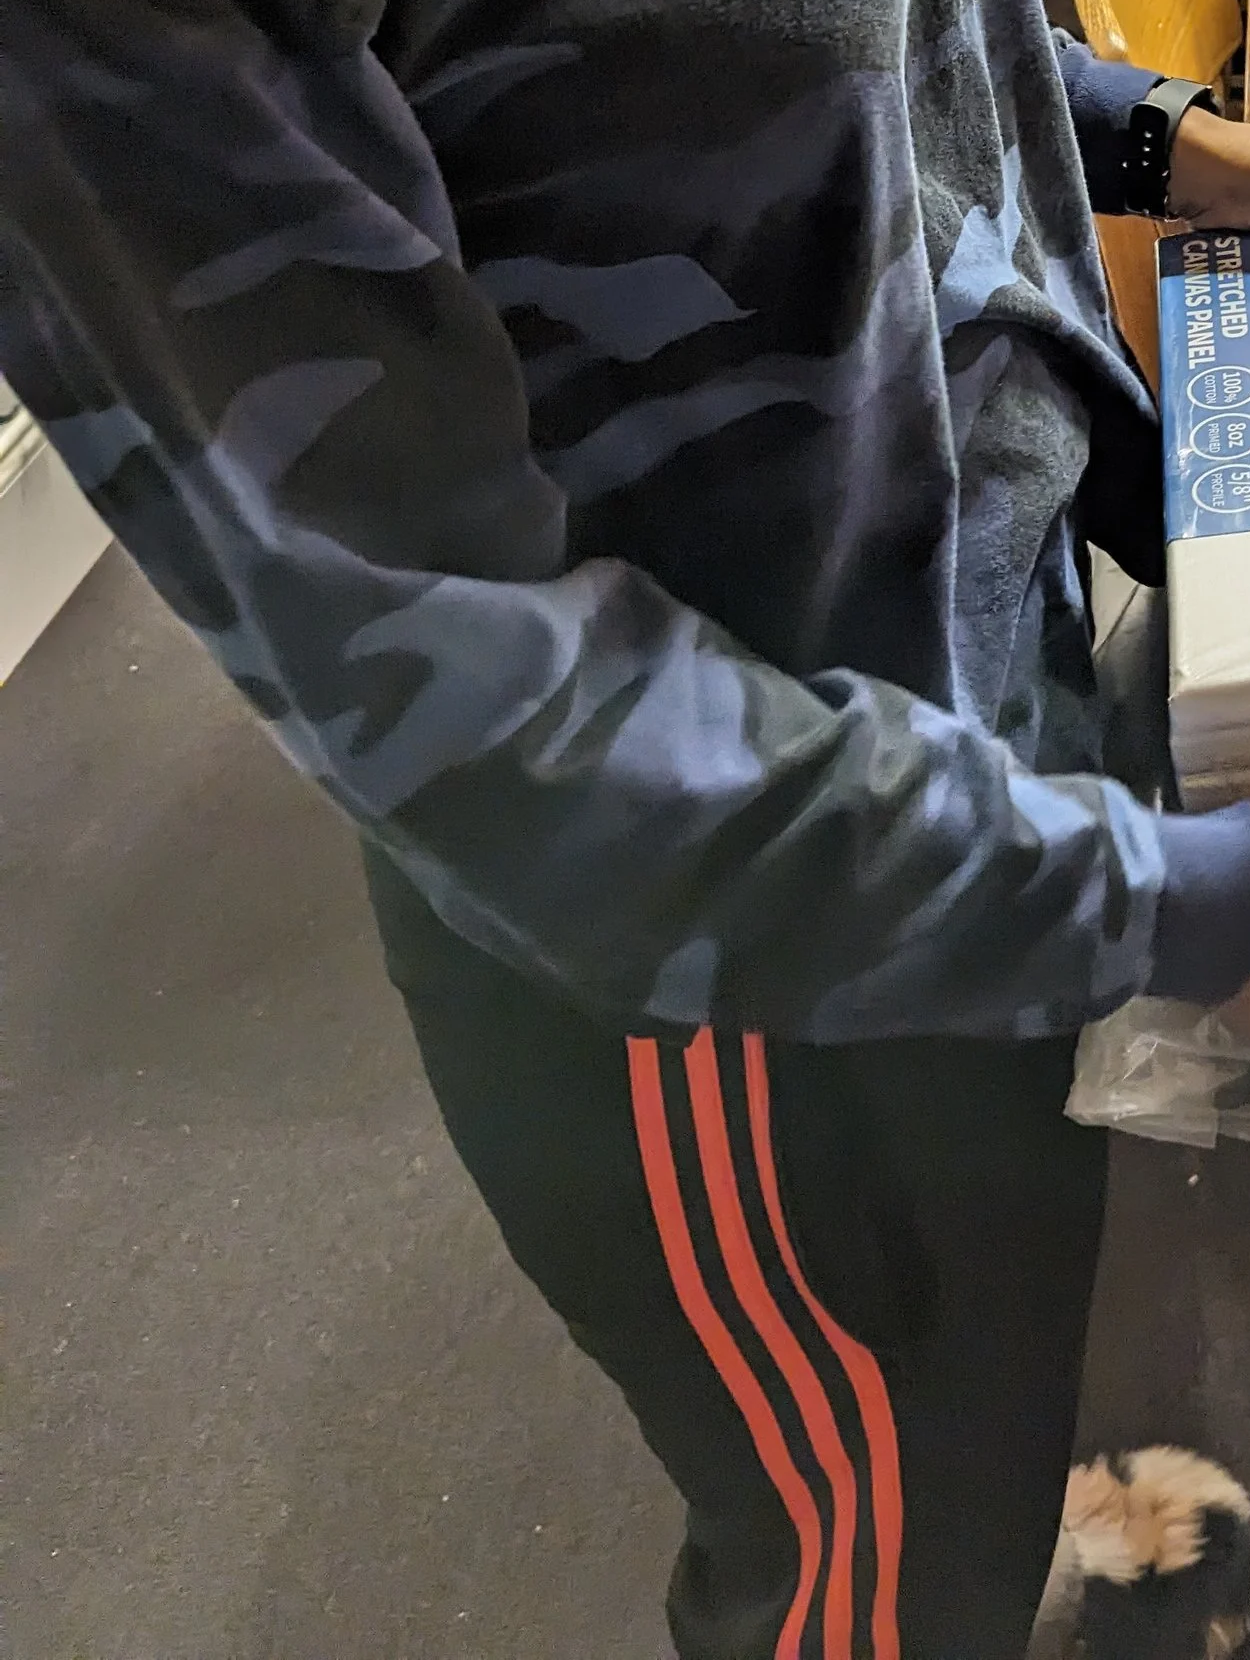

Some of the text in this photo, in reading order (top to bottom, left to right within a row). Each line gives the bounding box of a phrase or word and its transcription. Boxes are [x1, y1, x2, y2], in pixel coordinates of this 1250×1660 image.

[1214, 236, 1249, 338] STRETCHED
[1182, 240, 1216, 370] CANVAS PANEL
[1203, 374, 1217, 404] COTTON
[1222, 371, 1242, 403] 100%
[1207, 423, 1221, 453] PRIMED
[1211, 472, 1225, 507] PROFILE
